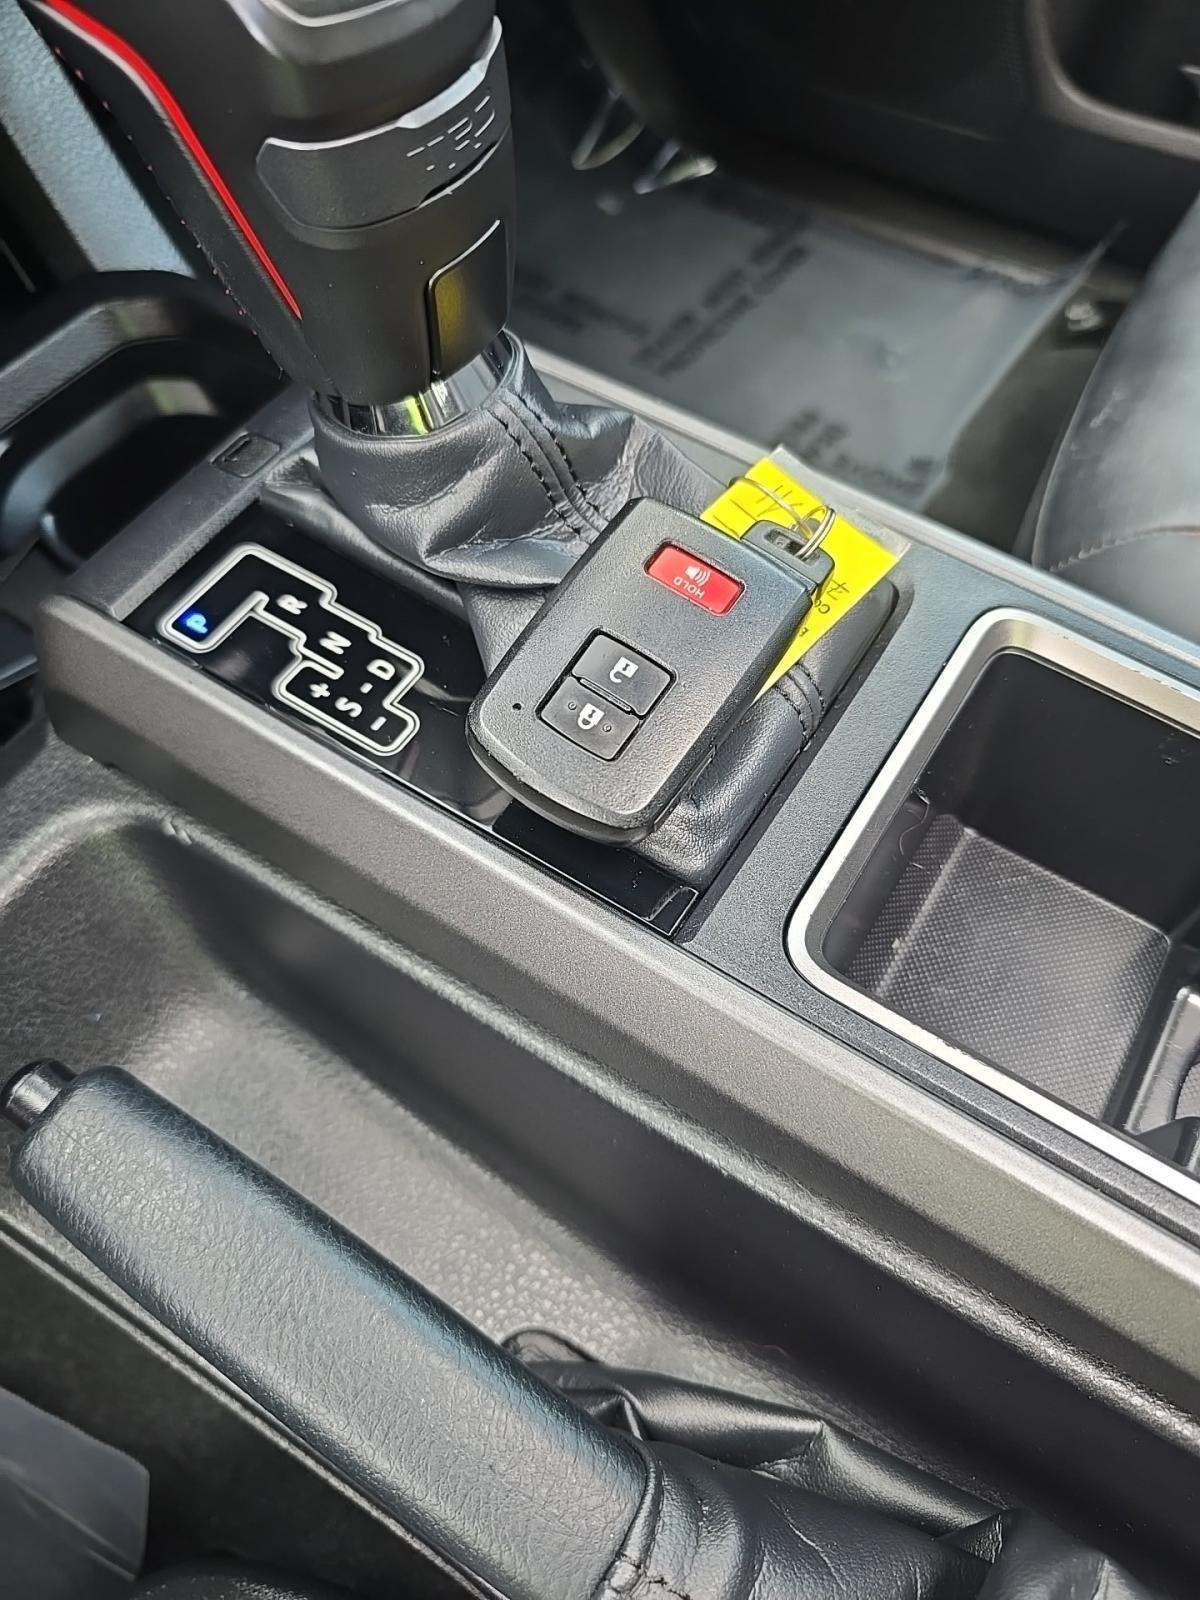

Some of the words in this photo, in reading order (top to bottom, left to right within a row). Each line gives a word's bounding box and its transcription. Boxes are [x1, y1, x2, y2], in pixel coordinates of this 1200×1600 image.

[673, 576, 706, 599] HOLD
[276, 594, 308, 615] R
[185, 612, 208, 633] P
[319, 631, 352, 655] N
[367, 659, 396, 680] D
[334, 697, 363, 717] S
